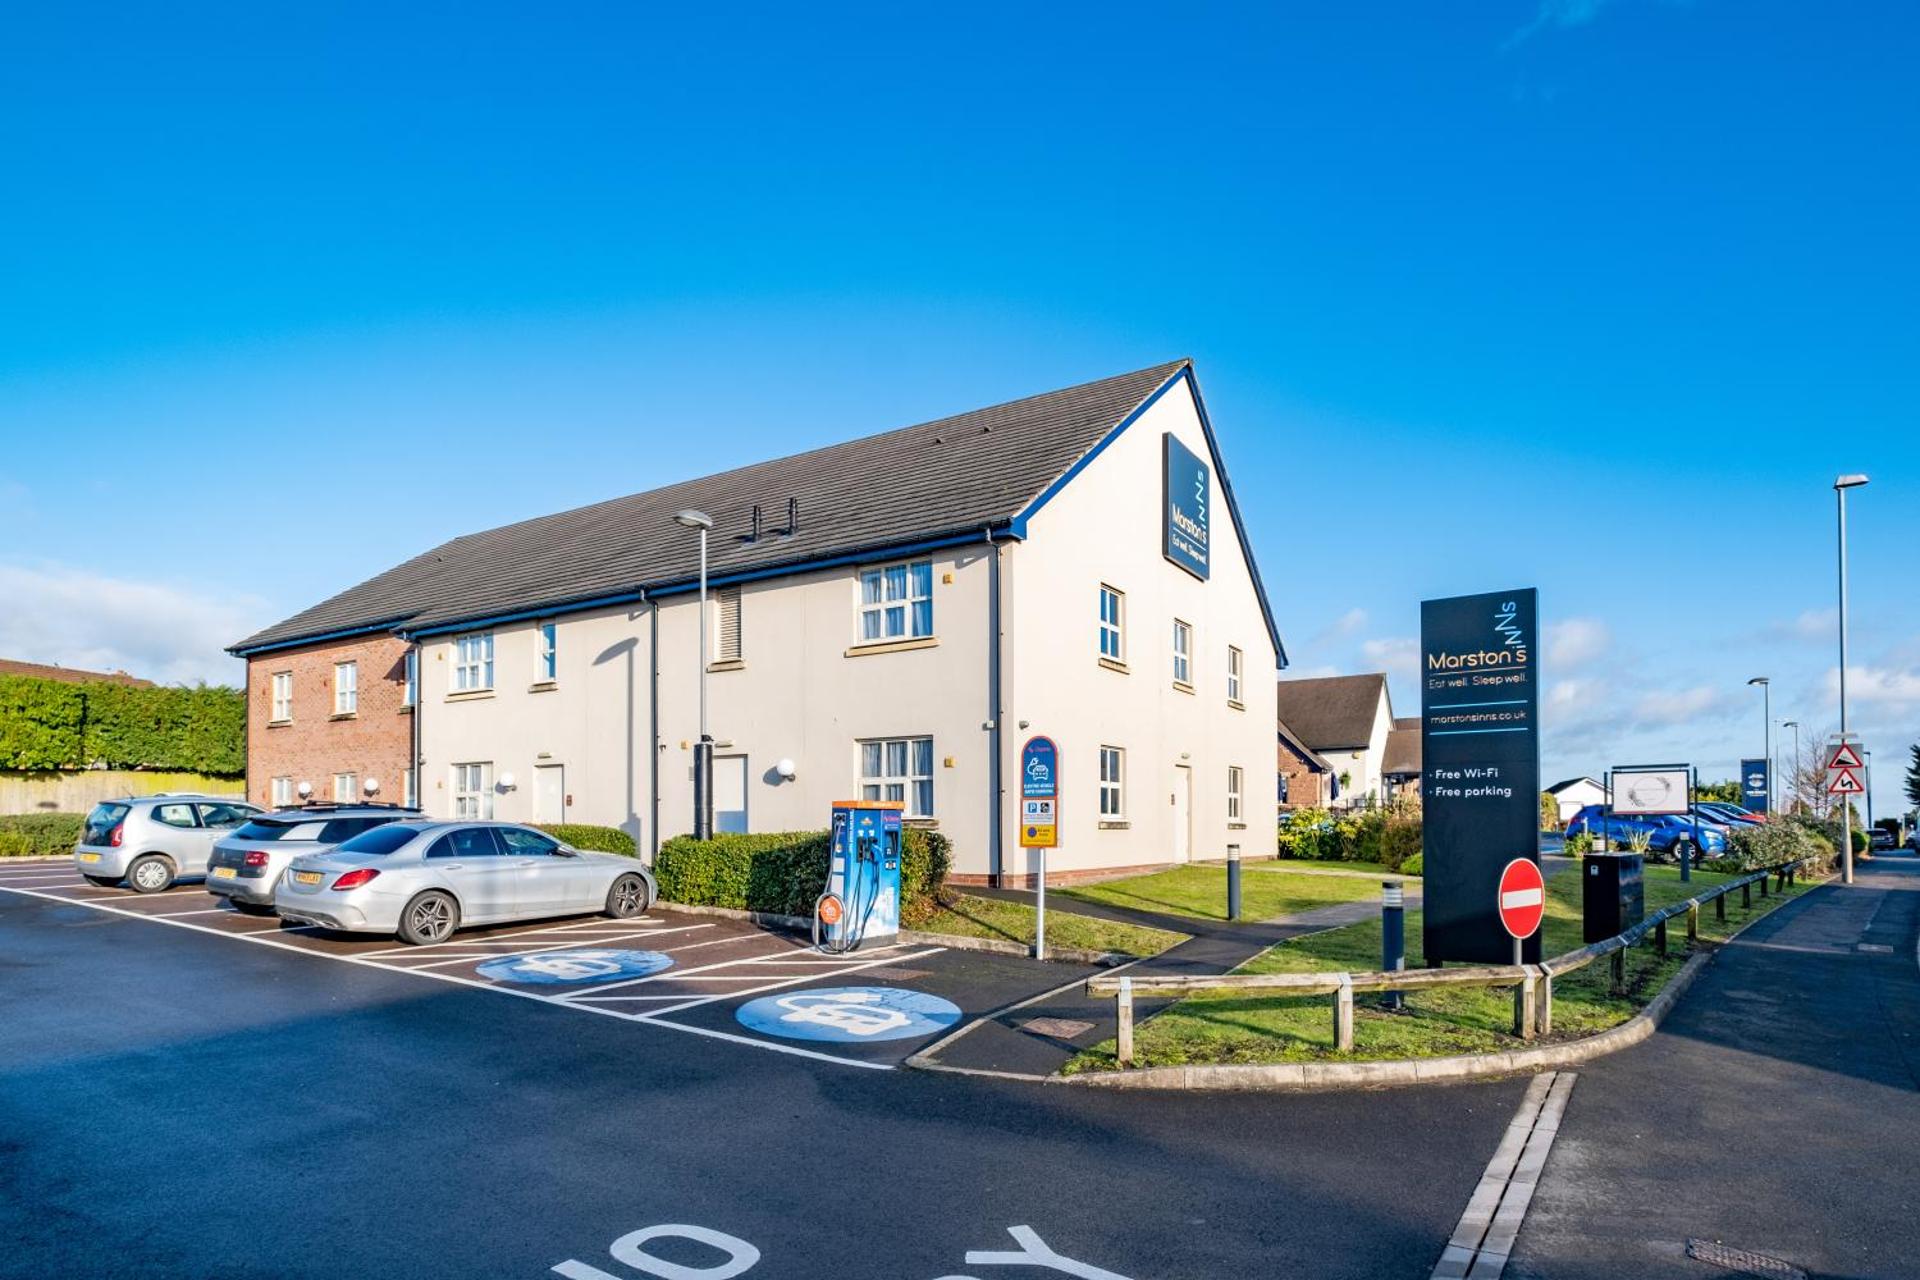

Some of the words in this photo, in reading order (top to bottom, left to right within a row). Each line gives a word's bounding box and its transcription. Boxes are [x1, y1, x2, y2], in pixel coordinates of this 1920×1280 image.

[1429, 679, 1446, 689] Eat
[1472, 675, 1503, 686] Sleep
[1430, 711, 1527, 725] marstonsinns.co.uk
[1435, 768, 1461, 779] Free
[1464, 767, 1499, 778] Wi-Fi
[1435, 786, 1461, 797] Free
[1464, 785, 1512, 798] parking
